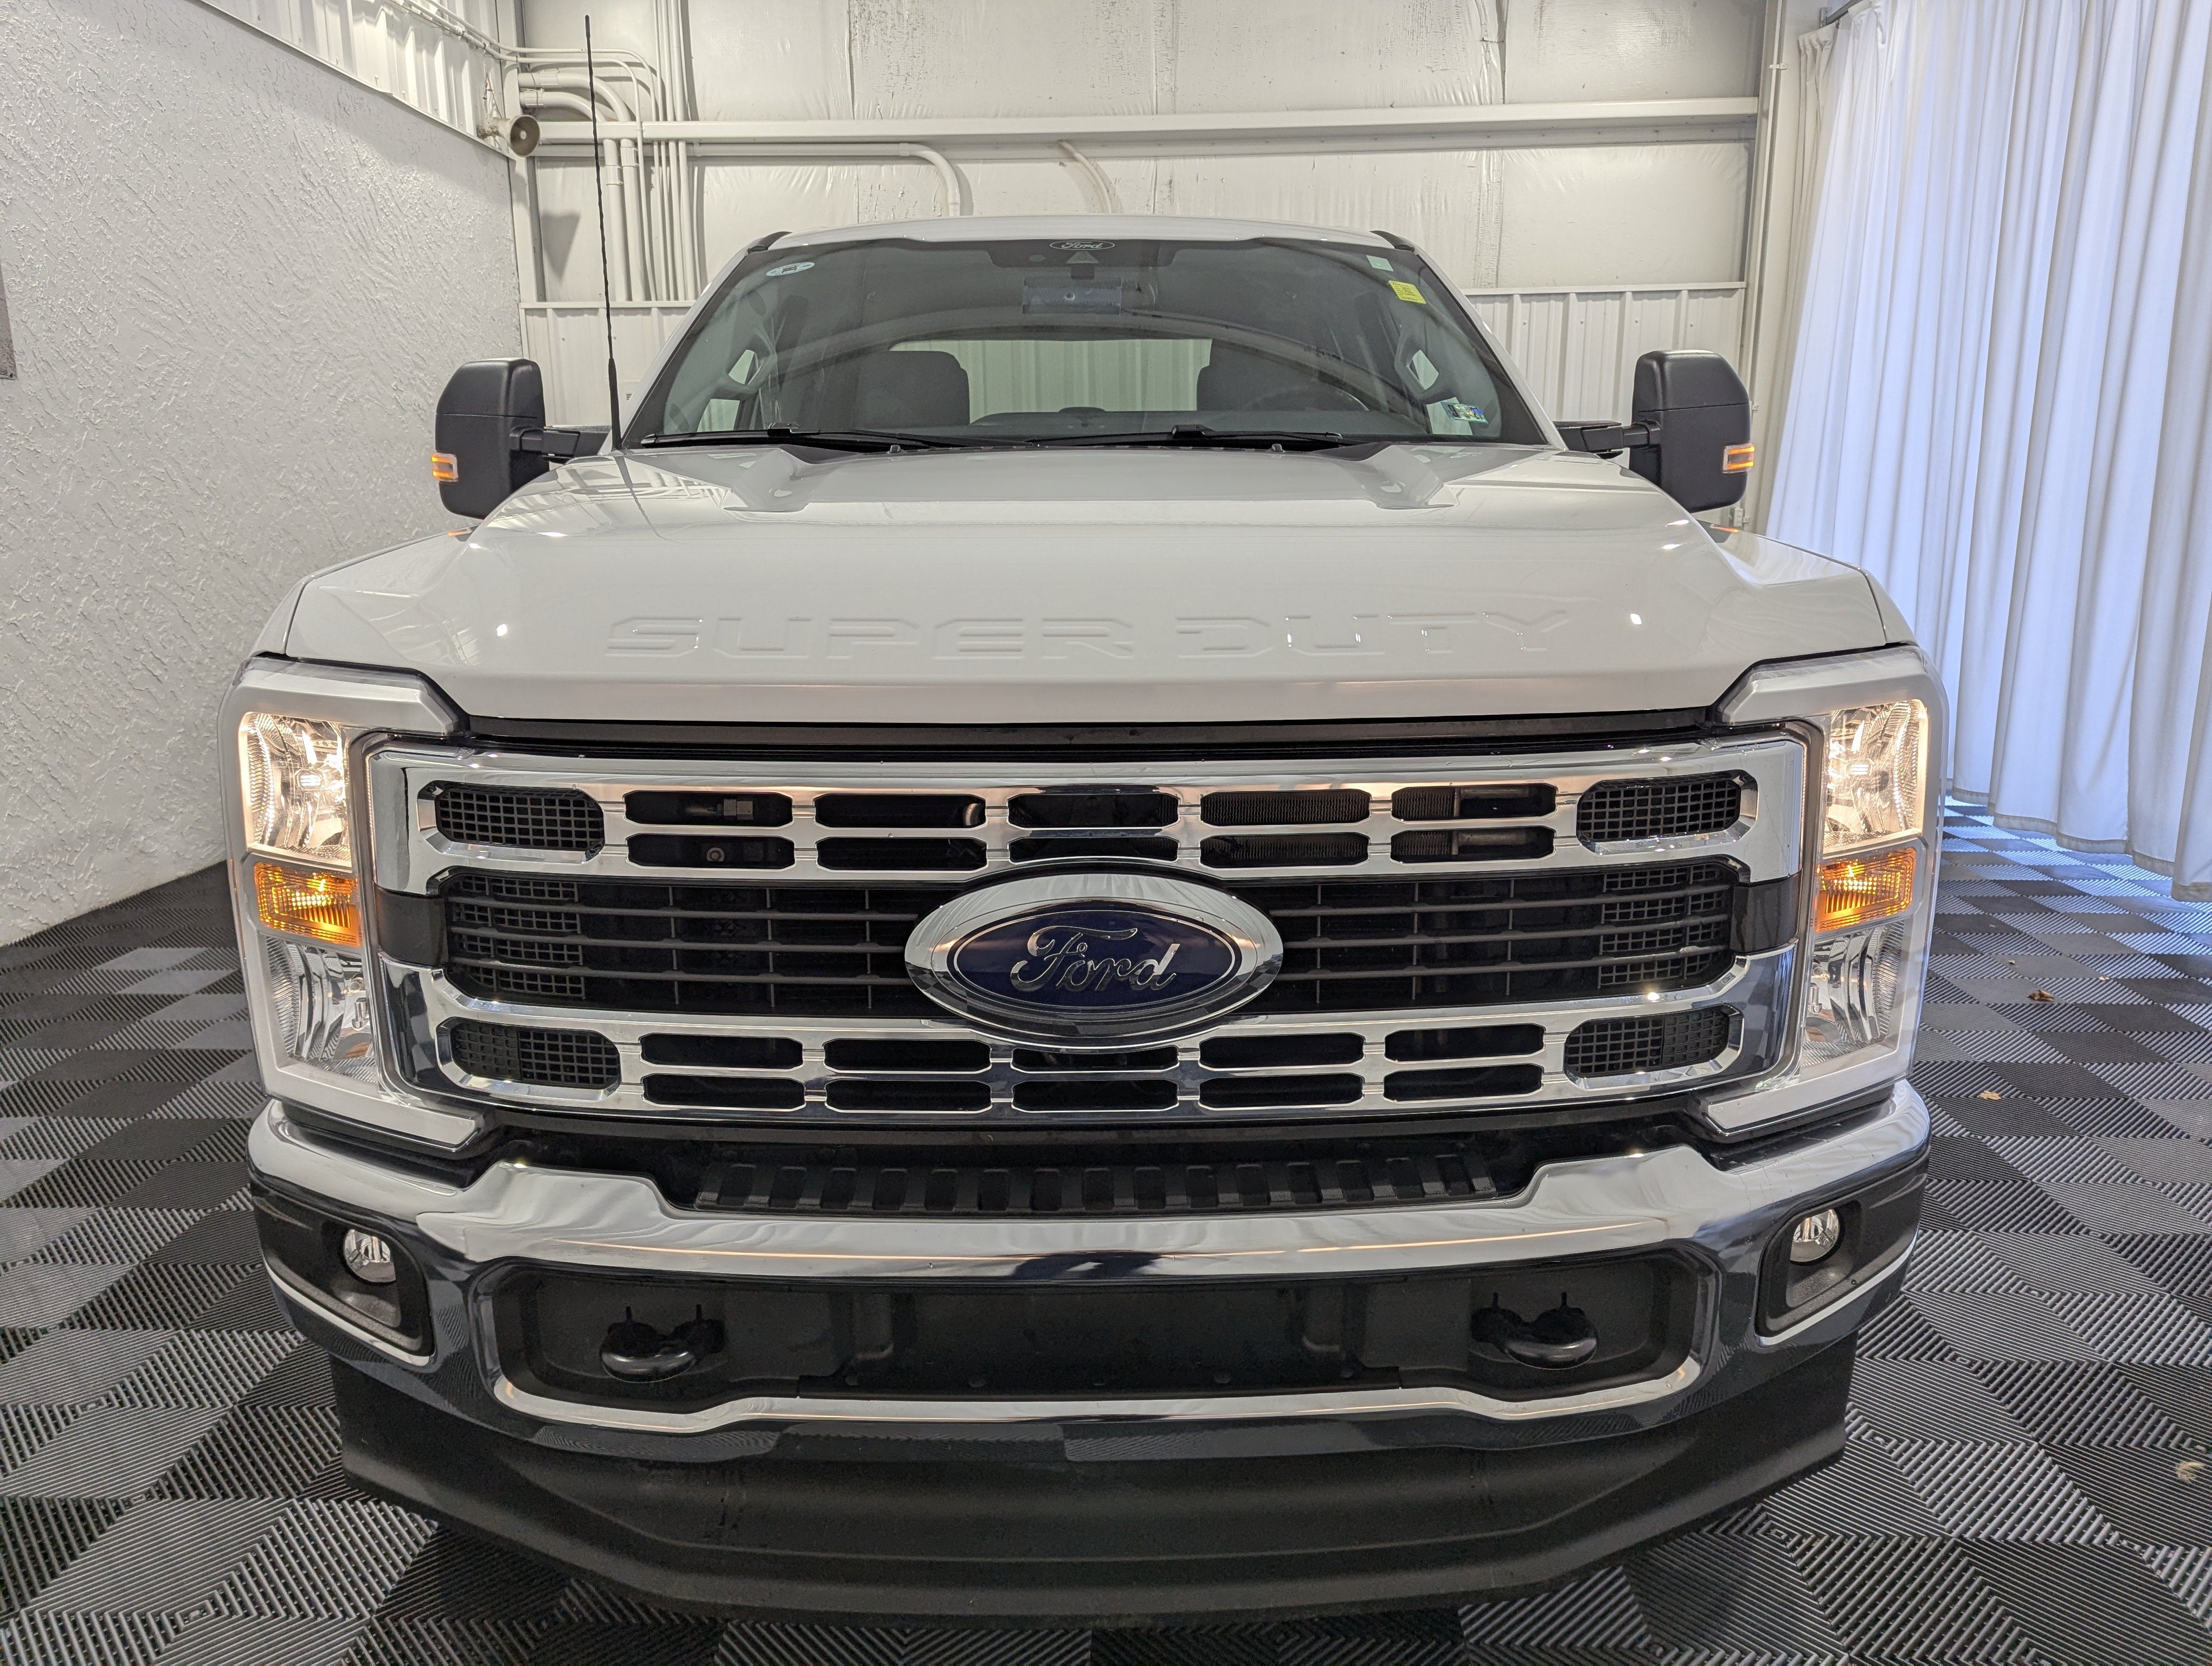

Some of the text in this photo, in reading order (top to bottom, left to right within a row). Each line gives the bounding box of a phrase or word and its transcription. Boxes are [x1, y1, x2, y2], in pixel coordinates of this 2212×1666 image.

[605, 610, 1570, 659] SUPER DUTY
[1011, 925, 1181, 991] Ford
